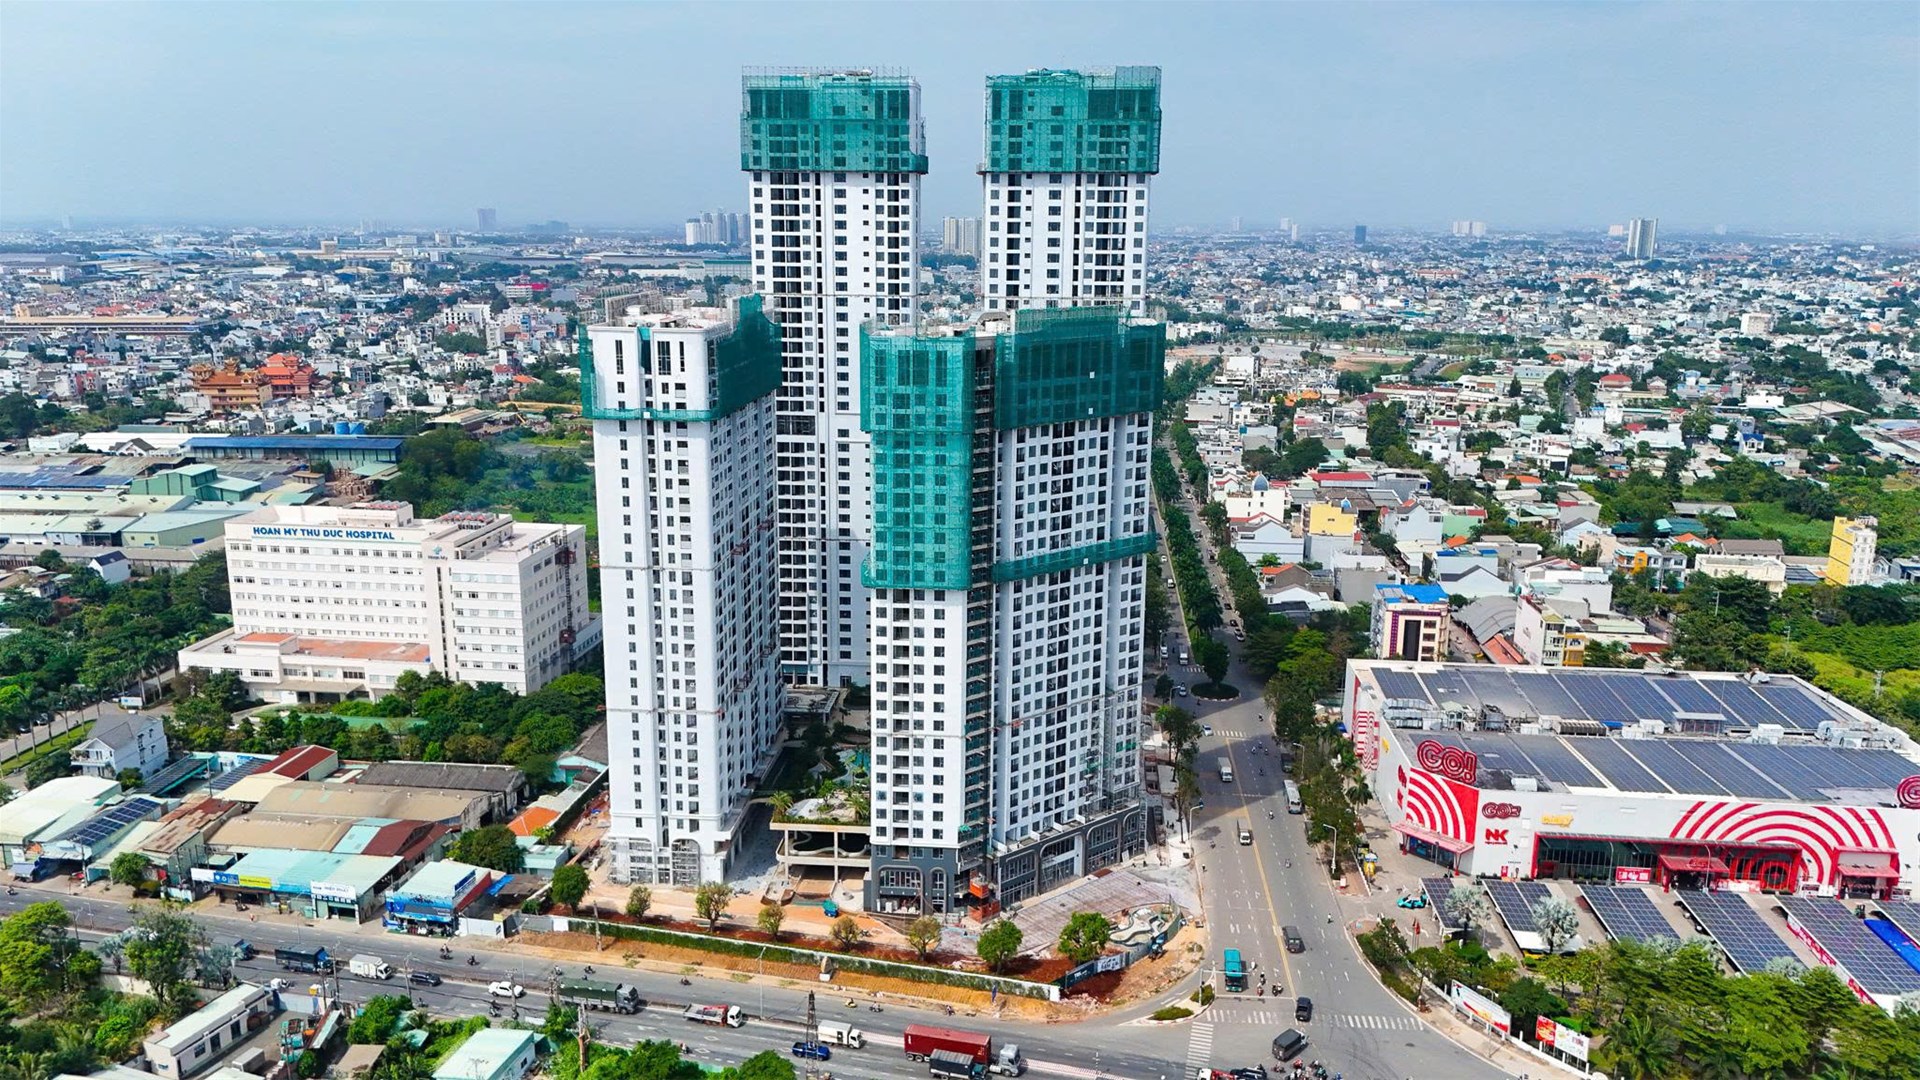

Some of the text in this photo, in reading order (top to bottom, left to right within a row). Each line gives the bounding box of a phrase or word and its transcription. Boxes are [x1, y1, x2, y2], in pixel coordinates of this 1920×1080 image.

[253, 527, 396, 540] HOAN MY THU DUC HOSPITAL
[1417, 740, 1477, 785] GO!
[1485, 828, 1509, 841] NK
